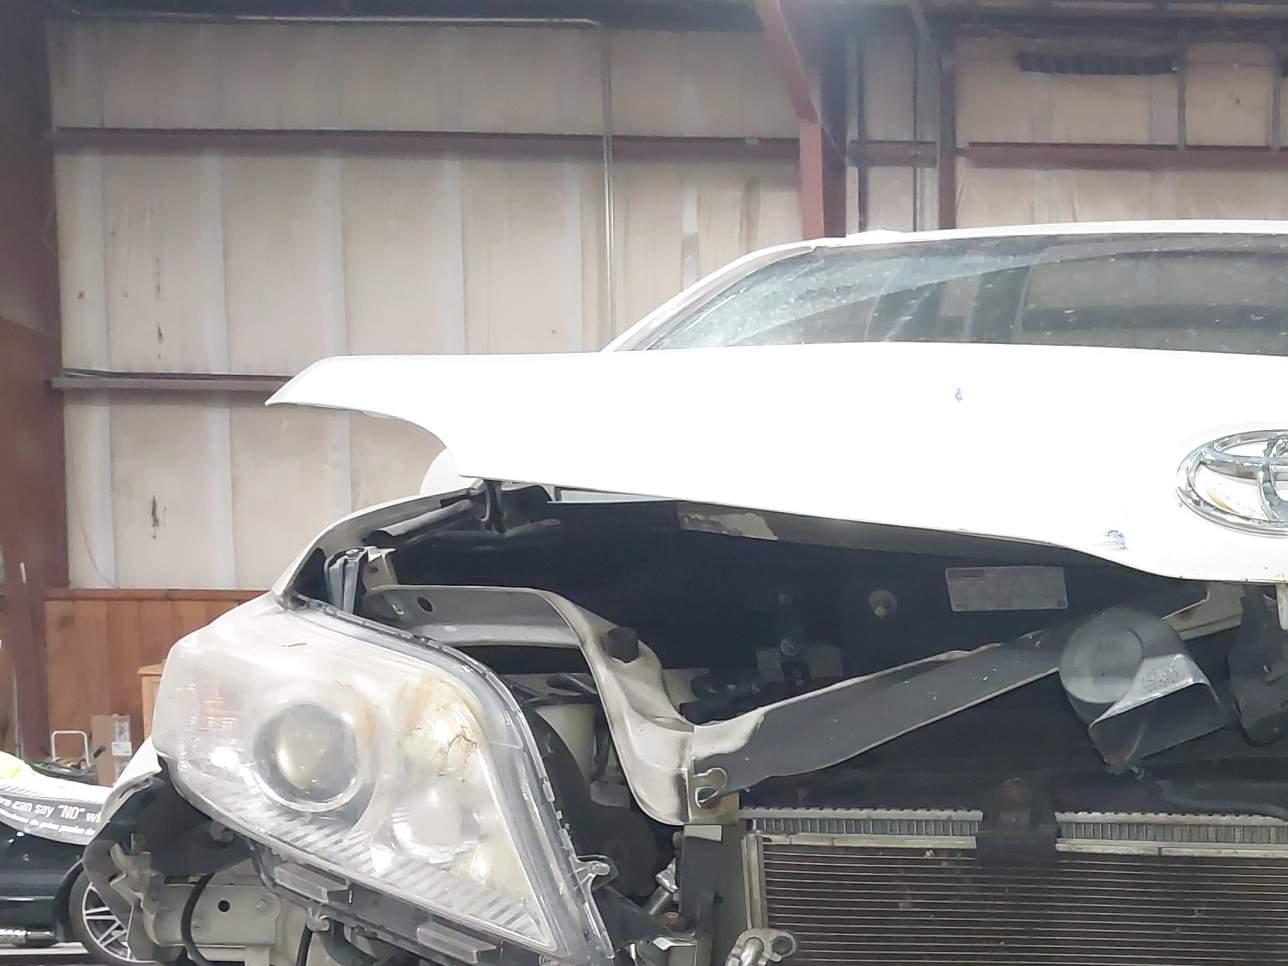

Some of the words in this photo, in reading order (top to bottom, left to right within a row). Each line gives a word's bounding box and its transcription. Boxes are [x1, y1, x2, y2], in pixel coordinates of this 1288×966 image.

[12, 801, 33, 813] can
[34, 804, 56, 818] say
[58, 804, 86, 820] "NO"
